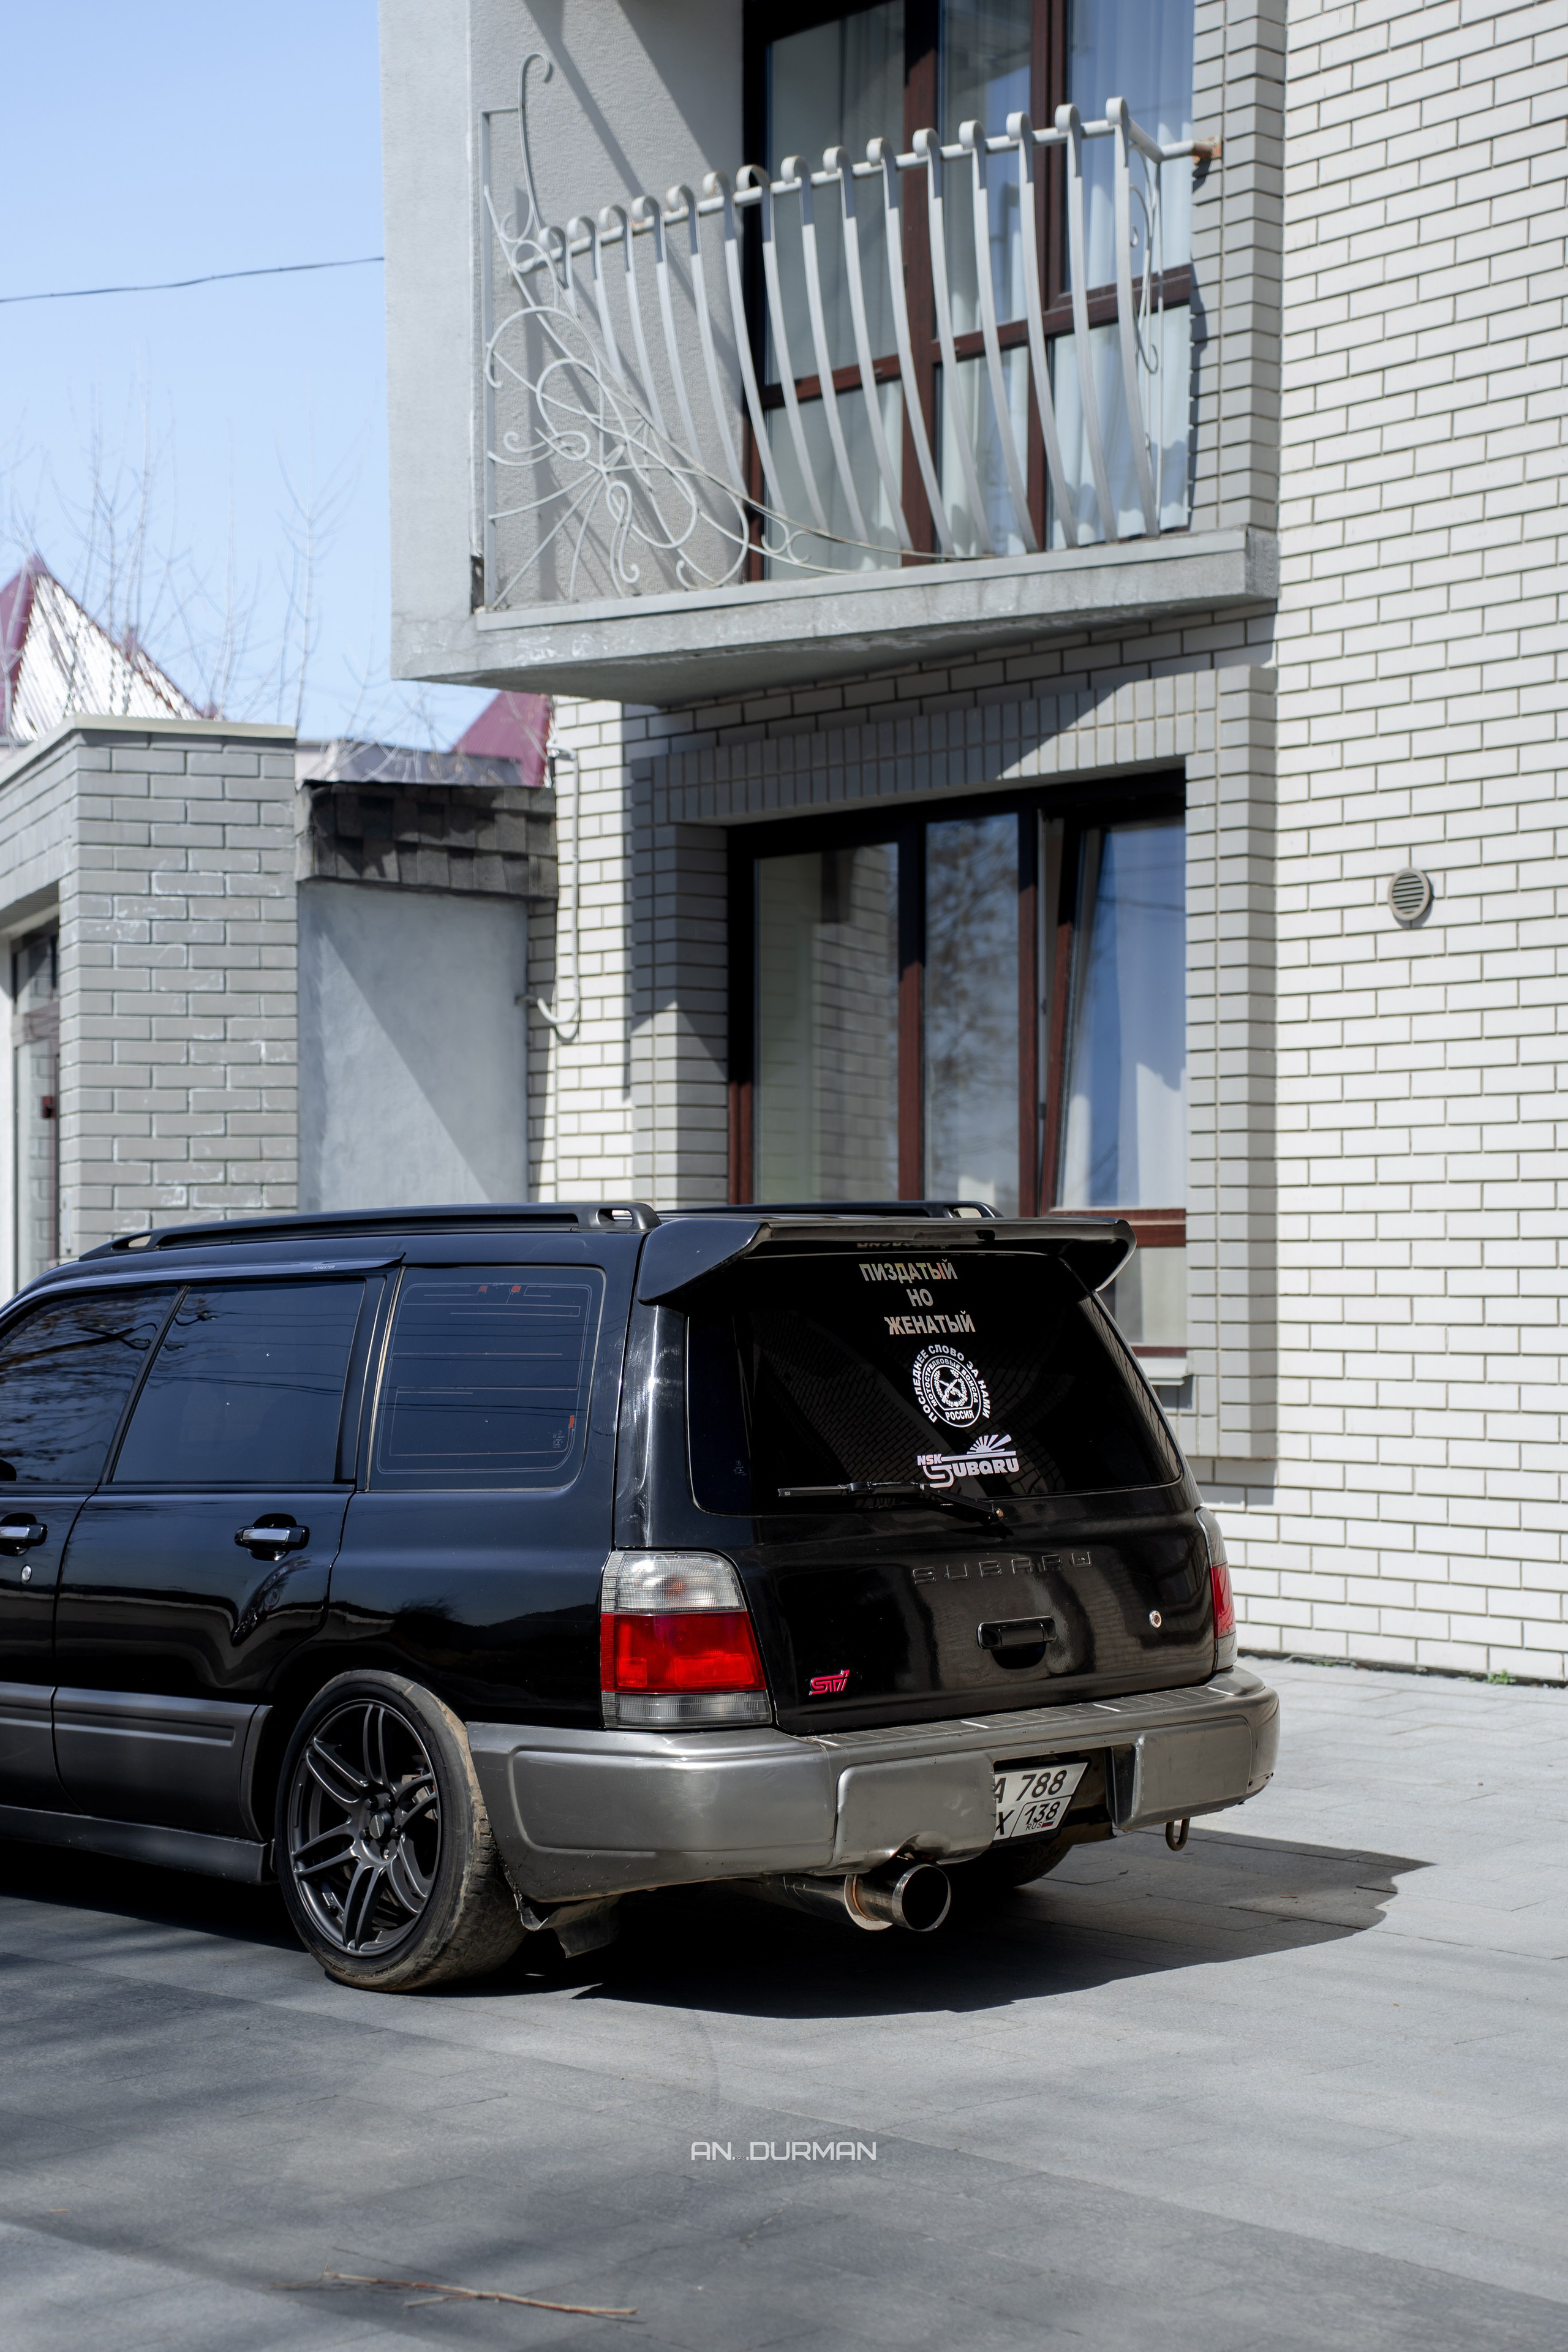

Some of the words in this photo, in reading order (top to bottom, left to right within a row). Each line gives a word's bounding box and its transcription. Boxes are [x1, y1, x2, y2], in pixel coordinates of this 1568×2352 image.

[859, 1259, 958, 1284] ПИЗДАТЫЙ
[906, 1289, 933, 1306] НО
[884, 1310, 976, 1335] ЖЕНАТЫЙ
[912, 1349, 938, 1423] ПОСЛЕДНЕЕ
[928, 1344, 965, 1361] СЛОВО
[967, 1360, 979, 1378] ЗА
[978, 1380, 990, 1419] НАМИ
[924, 1358, 961, 1407] МОТОСТРЕЛКОВЫЕ
[944, 1409, 974, 1421] РОССИЯ
[917, 1453, 942, 1466] NSK
[912, 1551, 1093, 1585] SUBARU
[1016, 1770, 1067, 1801] 788
[1024, 1801, 1060, 1825] 138
[1025, 1821, 1042, 1831] RUS
